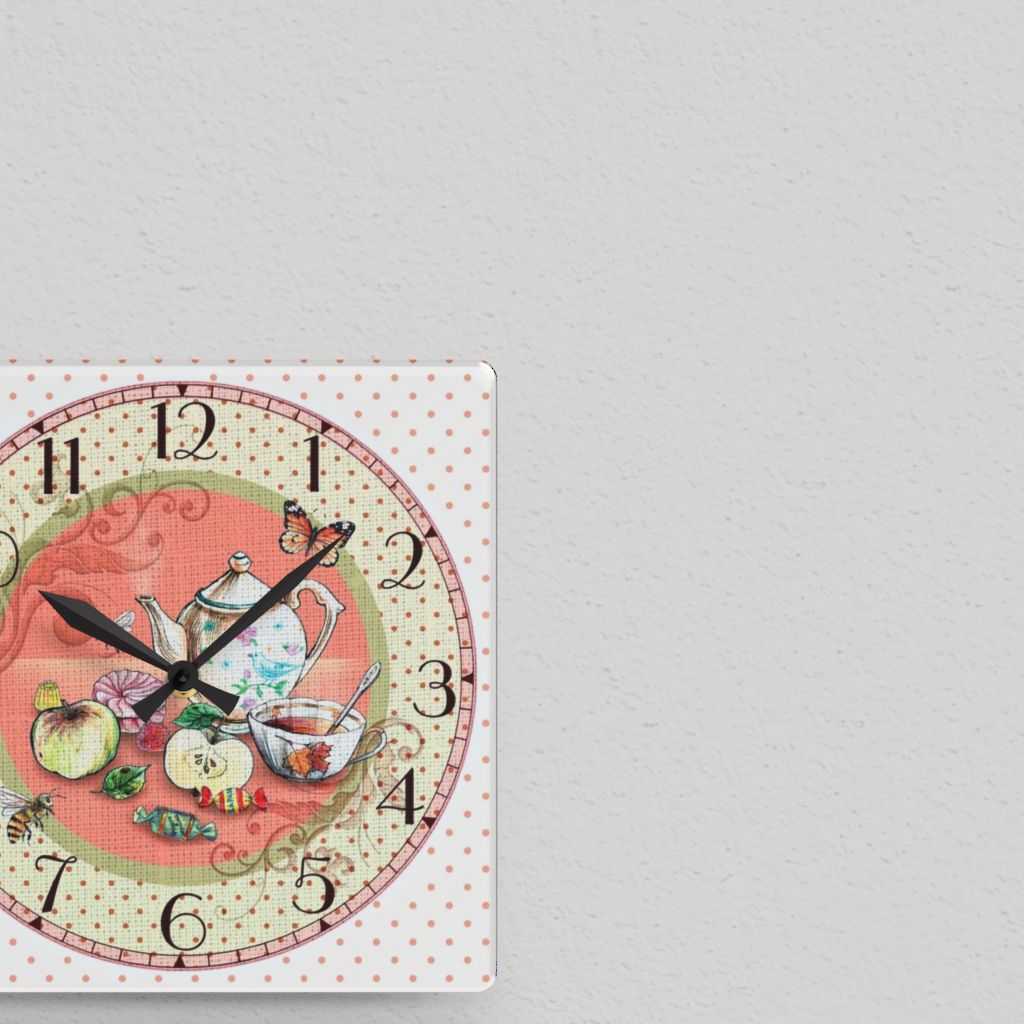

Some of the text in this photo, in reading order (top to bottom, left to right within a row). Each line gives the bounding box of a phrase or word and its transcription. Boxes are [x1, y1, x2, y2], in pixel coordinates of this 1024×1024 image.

[150, 401, 218, 460] 12
[40, 437, 80, 495] 11
[303, 434, 321, 493] 1
[381, 531, 426, 590] 2
[413, 659, 457, 718] 3
[377, 767, 425, 825] 4
[35, 855, 78, 913] 7
[293, 857, 336, 914] 5
[160, 893, 207, 951] 6
